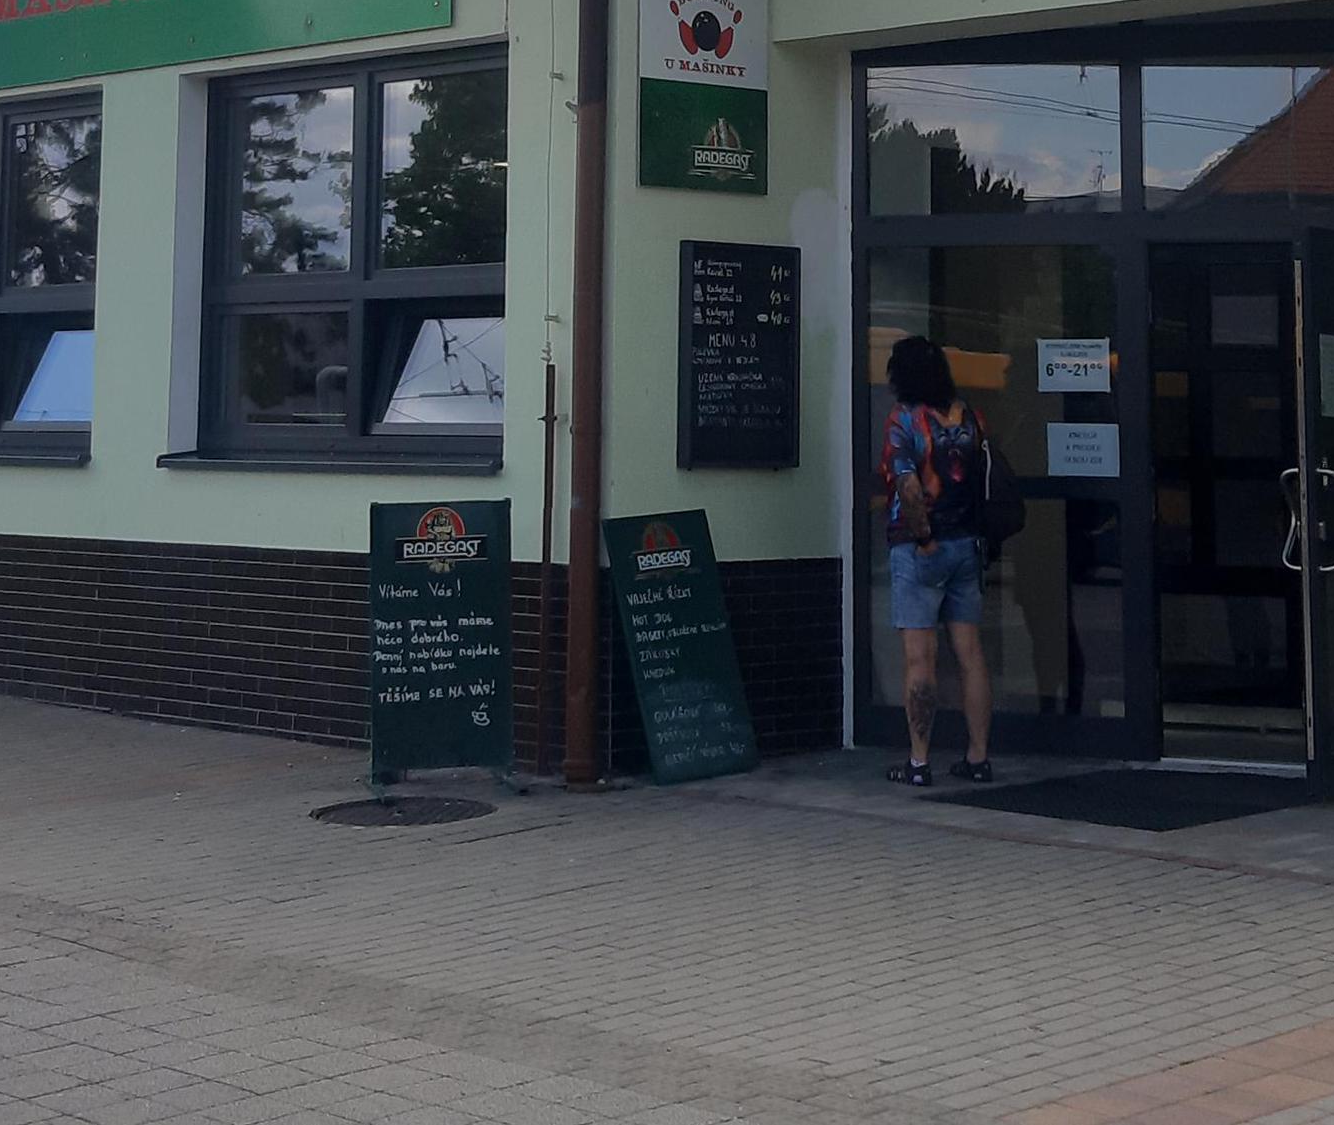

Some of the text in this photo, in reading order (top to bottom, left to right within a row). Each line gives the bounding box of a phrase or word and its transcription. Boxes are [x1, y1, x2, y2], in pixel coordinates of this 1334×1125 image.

[665, 59, 747, 77] U MAŠINKY
[695, 150, 751, 171] RADEGAST
[708, 333, 735, 347] MENU
[403, 540, 481, 558] RADEGAST
[636, 550, 691, 571] RADEGAST
[378, 583, 419, 599] Vítáme
[409, 619, 427, 631] pro
[429, 688, 443, 699] SE
[449, 686, 465, 699] NA
